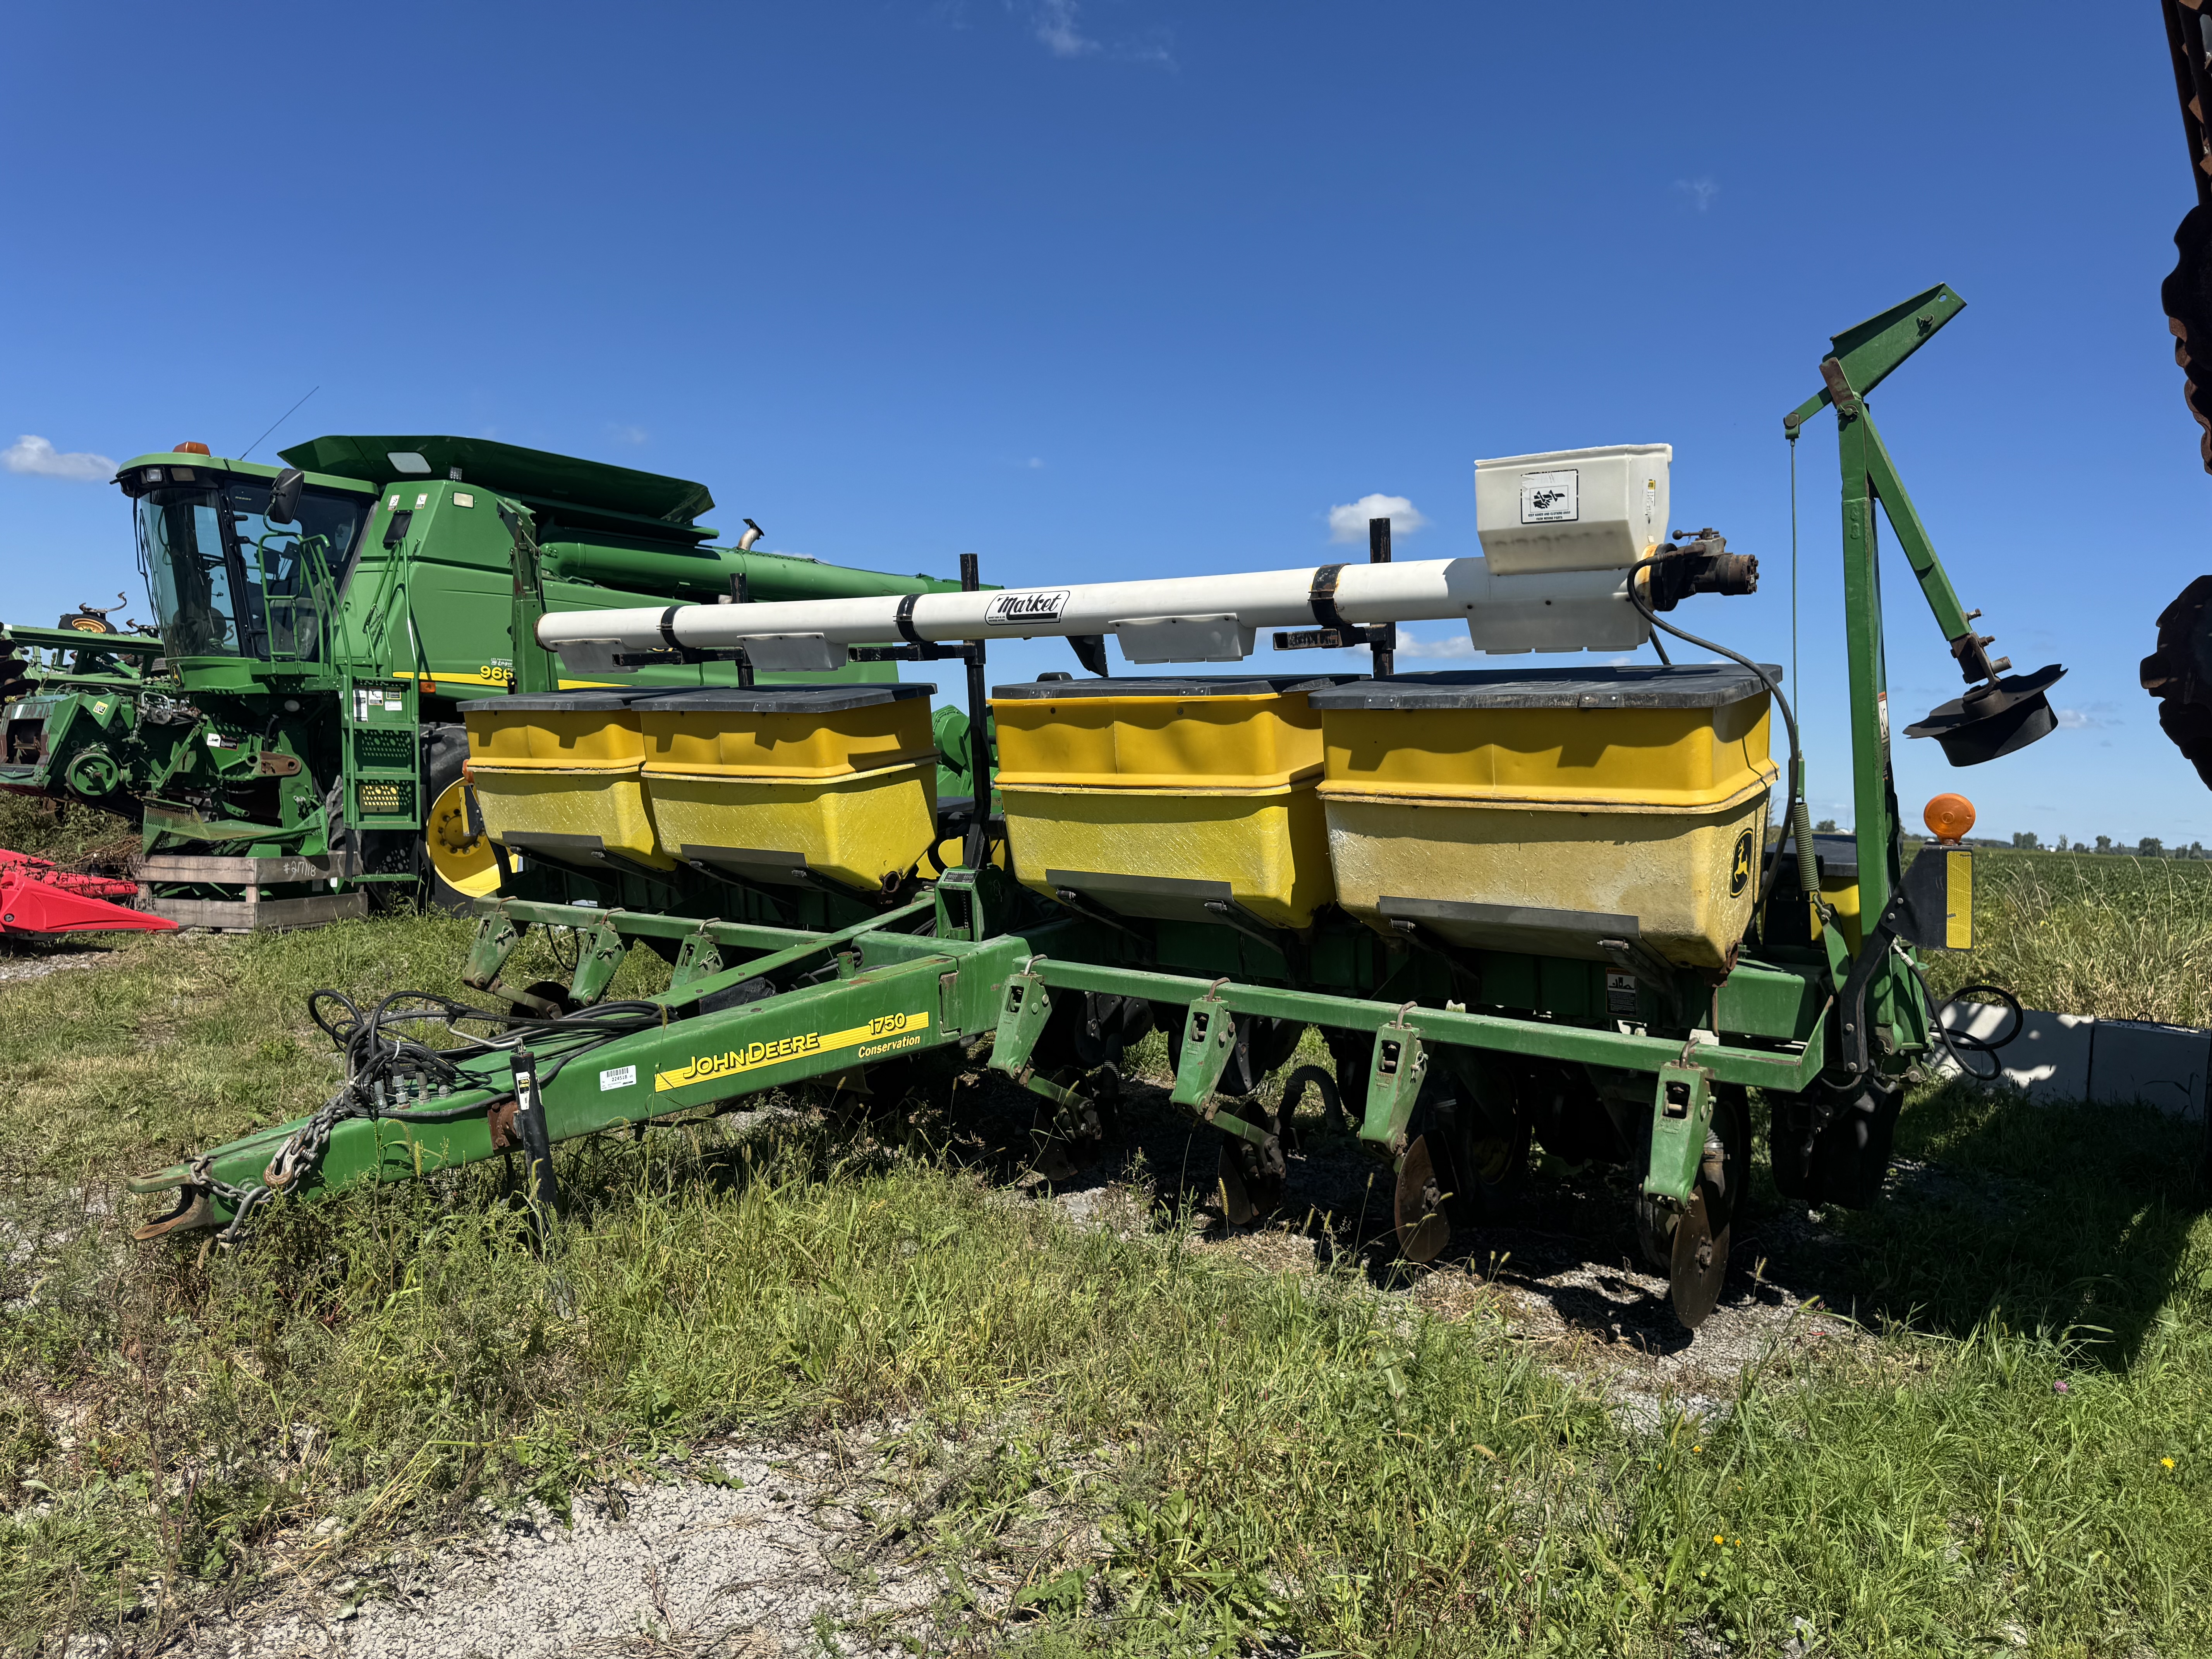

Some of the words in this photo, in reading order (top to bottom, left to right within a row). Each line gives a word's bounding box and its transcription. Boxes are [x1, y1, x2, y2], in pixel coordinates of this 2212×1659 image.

[997, 594, 1062, 613] Market
[868, 1012, 906, 1034] 1750
[683, 1048, 746, 1079] JOHN
[748, 1032, 819, 1062] DEERE
[858, 1035, 921, 1058] Conservation
